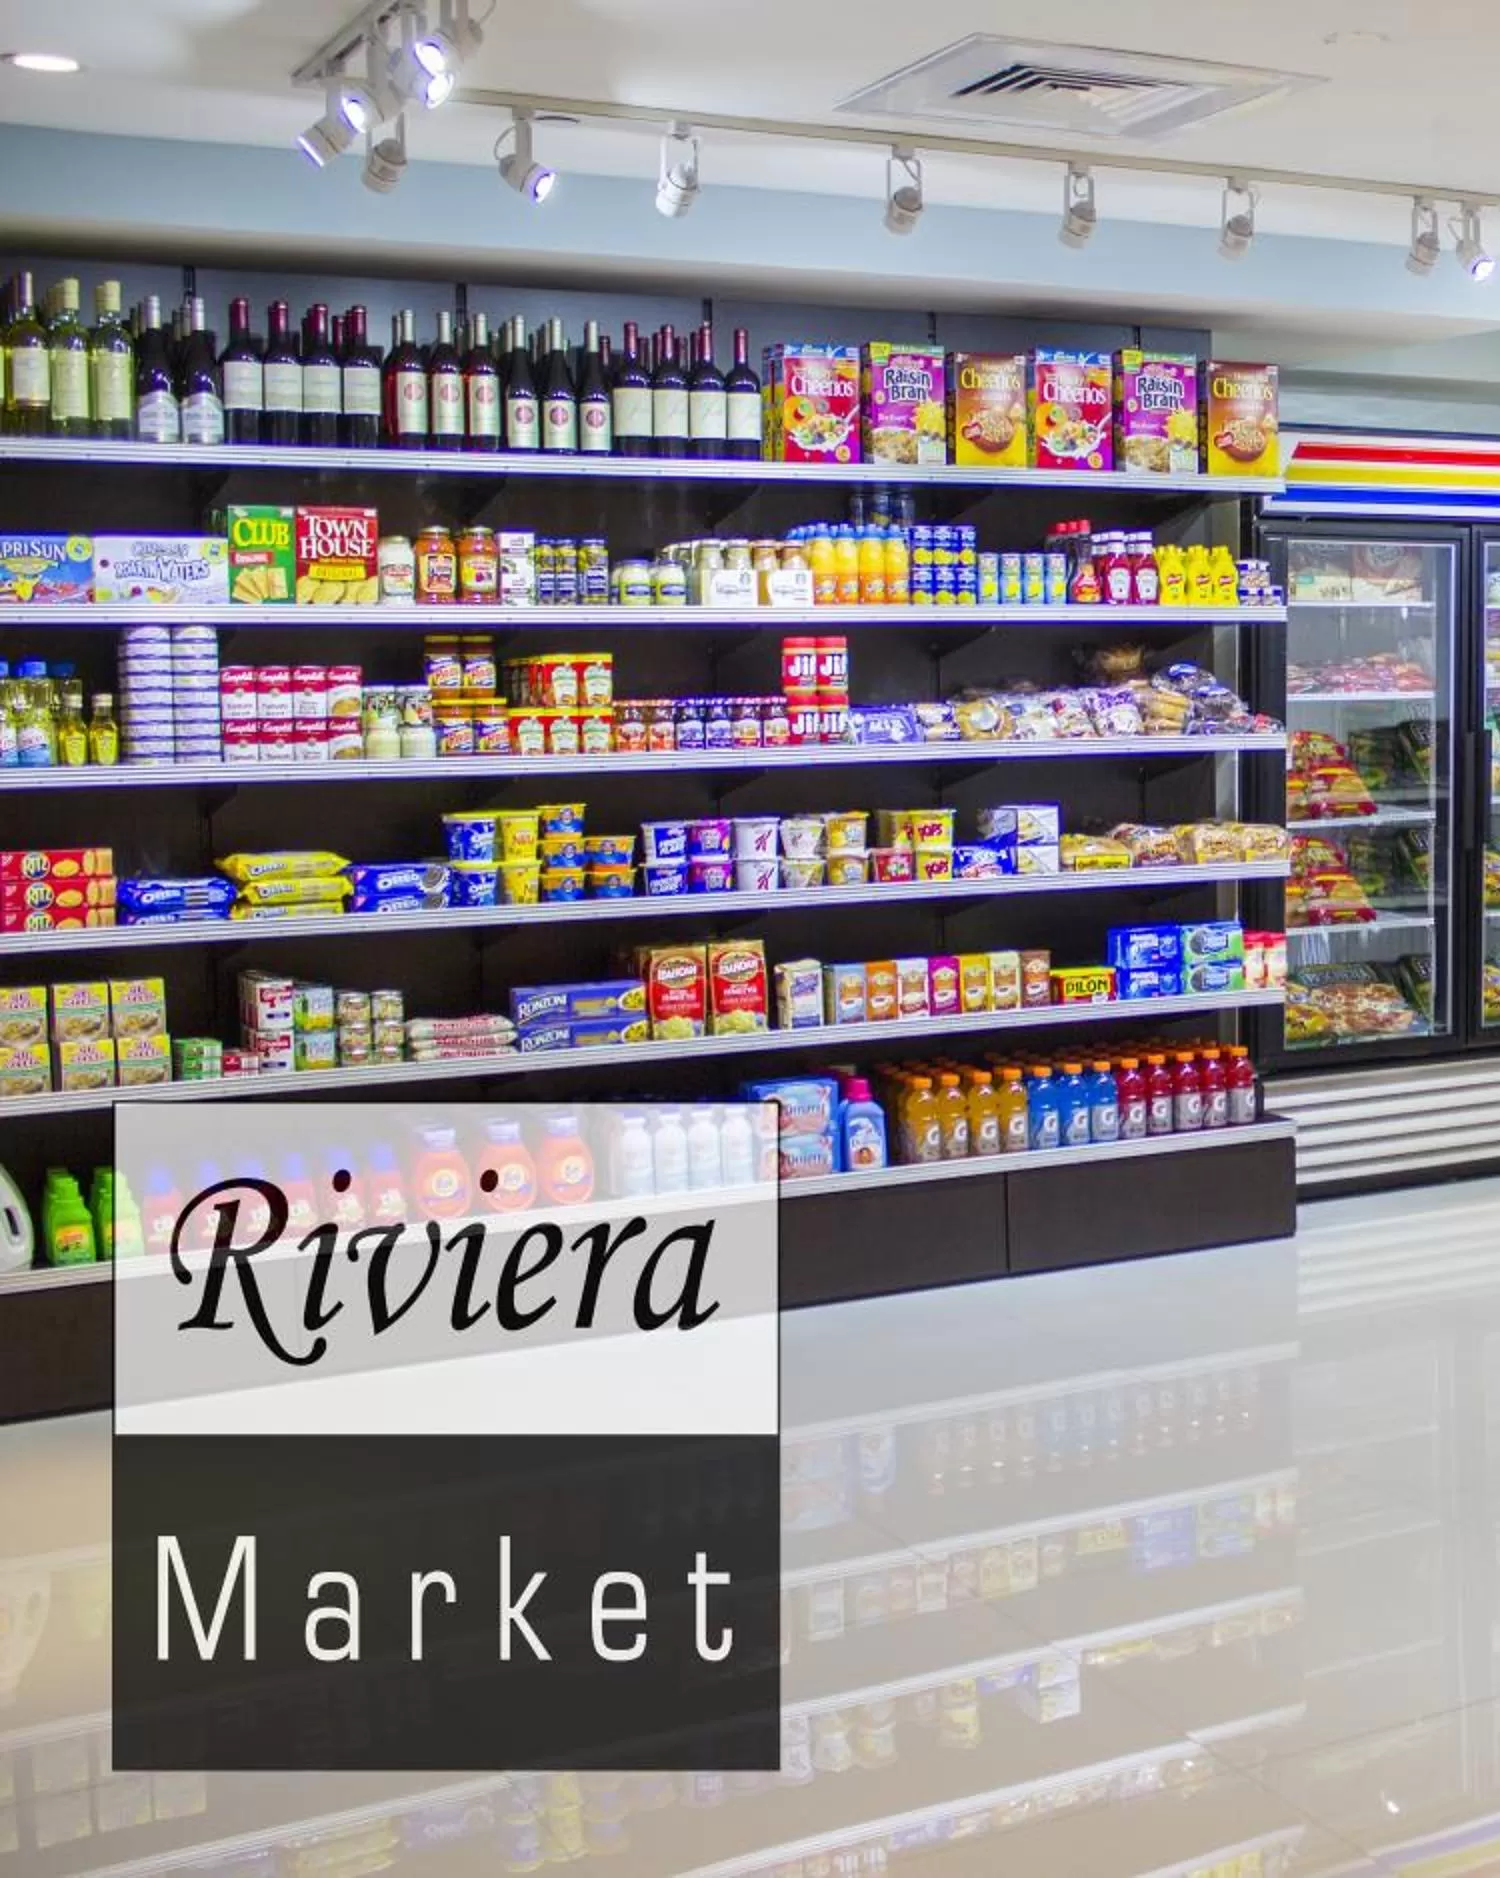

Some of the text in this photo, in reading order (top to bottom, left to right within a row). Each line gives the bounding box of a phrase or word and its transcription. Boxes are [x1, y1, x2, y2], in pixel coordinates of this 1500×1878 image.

[885, 369, 931, 387] Raisin
[1137, 377, 1183, 396] Raisin
[890, 385, 928, 400] Bran
[1143, 394, 1179, 409] Bran
[233, 517, 290, 547] CLUB
[304, 515, 369, 538] TOWN
[300, 536, 375, 559] HOUSE
[1065, 979, 1108, 995] PILON
[518, 993, 567, 1018] RONZONI
[1152, 1101, 1167, 1118] G
[1188, 1097, 1201, 1114] G
[1213, 1094, 1226, 1112] G
[1073, 1111, 1088, 1129] G
[1102, 1108, 1115, 1125] G
[1130, 1105, 1144, 1123] G
[954, 1121, 967, 1141] G
[981, 1120, 996, 1139] G
[1010, 1116, 1024, 1134] G
[1044, 1115, 1057, 1132] G
[927, 1126, 940, 1145] G
